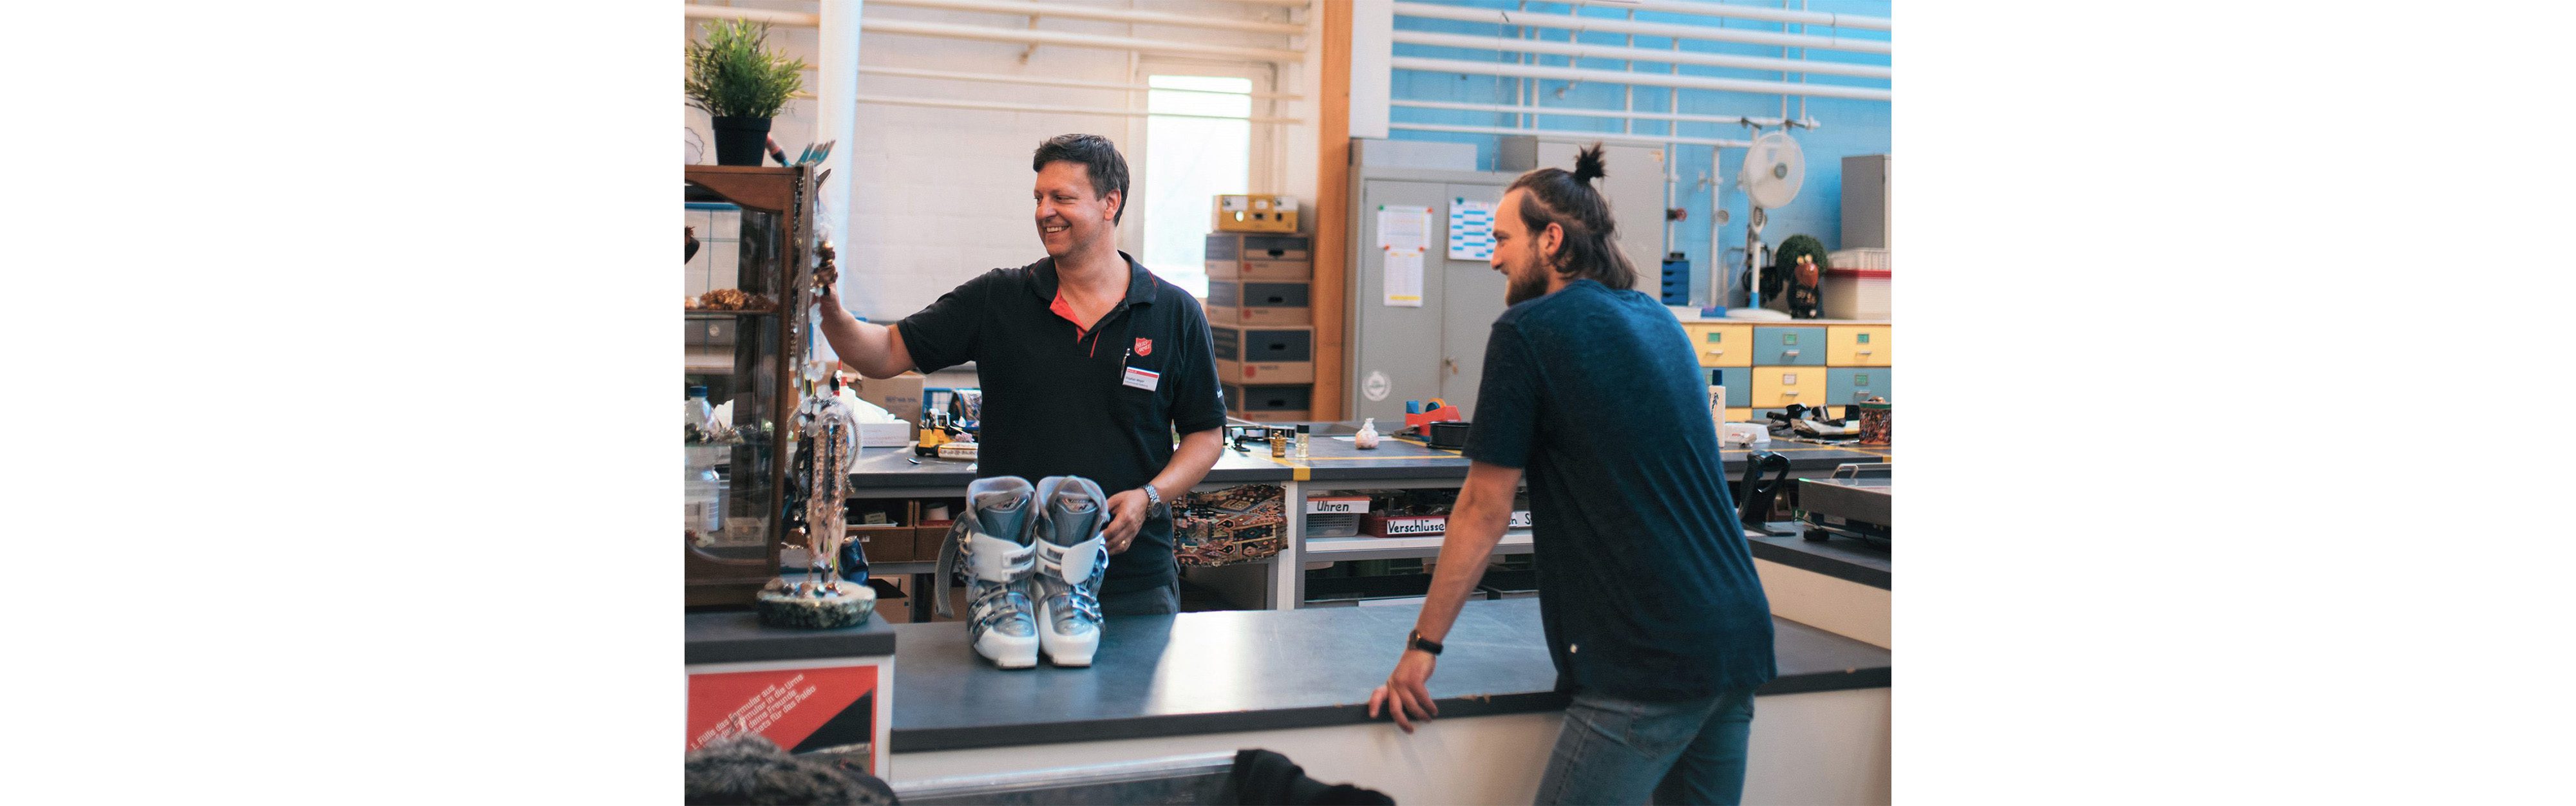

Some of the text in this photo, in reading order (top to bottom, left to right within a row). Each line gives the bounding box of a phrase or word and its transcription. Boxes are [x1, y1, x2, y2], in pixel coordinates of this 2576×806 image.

[1317, 500, 1350, 512] Uhren
[1524, 512, 1531, 525] S
[1387, 519, 1445, 534] Verschlüsse
[765, 695, 775, 705] in
[774, 687, 786, 698] die
[784, 673, 804, 690] Urne
[697, 729, 716, 745] Fülle
[715, 718, 730, 732] das
[728, 695, 761, 722] Formular
[761, 684, 775, 698] aus
[748, 689, 797, 729] deine Freunde
[751, 719, 772, 738] ckets
[770, 710, 782, 722] für
[782, 700, 797, 713] das
